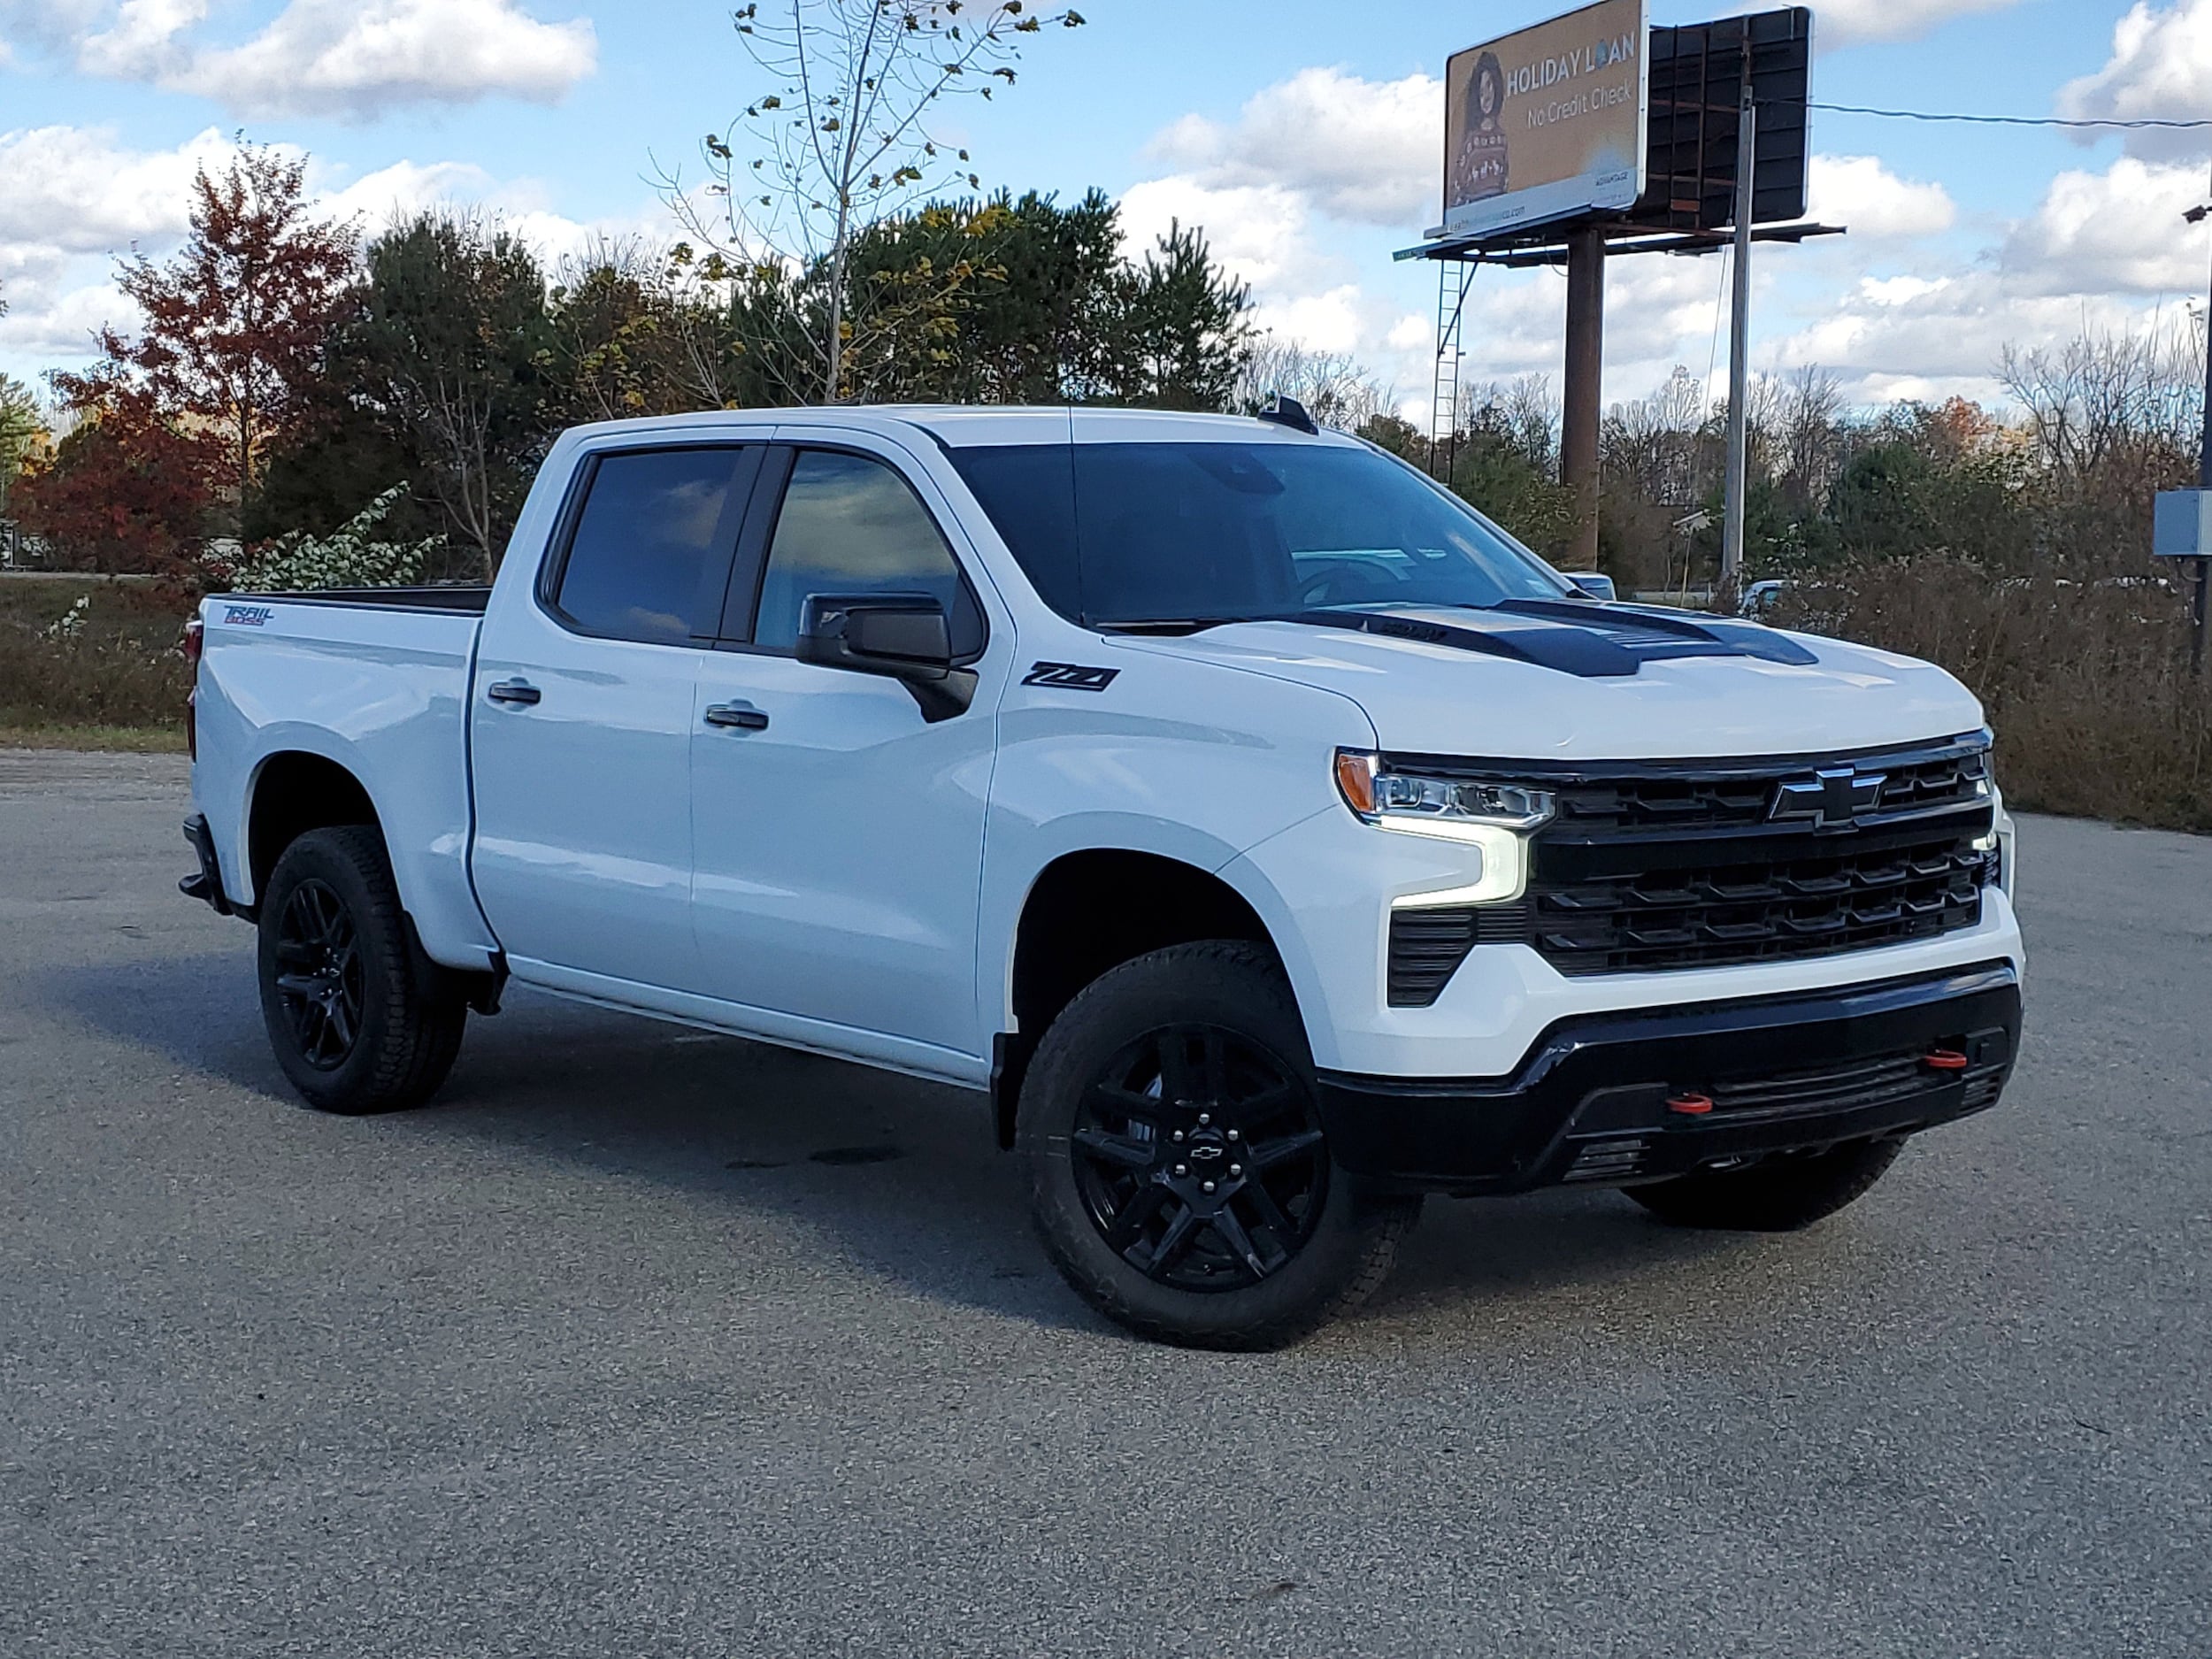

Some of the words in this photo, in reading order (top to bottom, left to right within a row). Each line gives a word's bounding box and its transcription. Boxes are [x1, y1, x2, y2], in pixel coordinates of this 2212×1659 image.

[1507, 49, 1581, 97] HOLIDAY
[1527, 109, 1544, 128] No
[1548, 95, 1587, 122] Credit
[1593, 78, 1631, 110] Check
[224, 605, 274, 618] TRAIL
[1020, 661, 1121, 692] Z71
